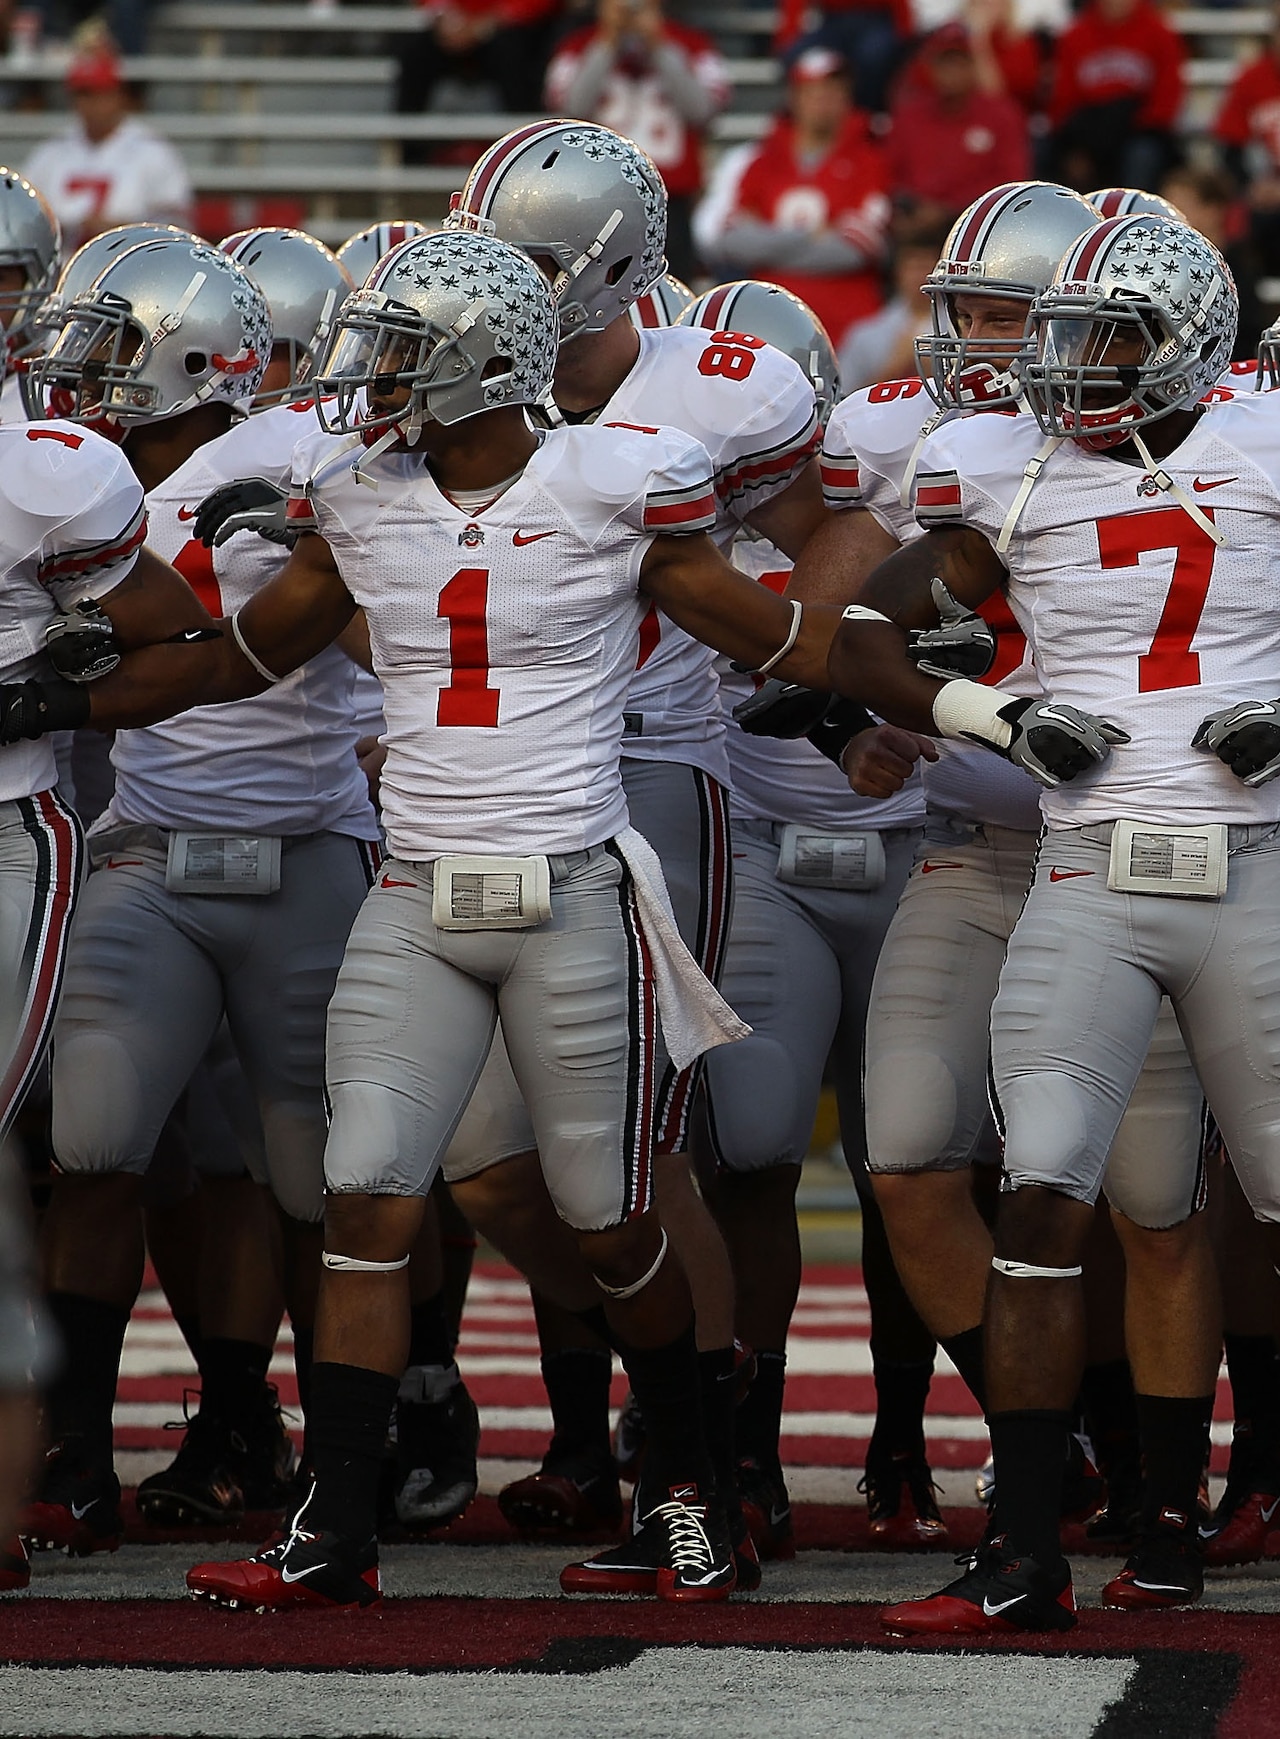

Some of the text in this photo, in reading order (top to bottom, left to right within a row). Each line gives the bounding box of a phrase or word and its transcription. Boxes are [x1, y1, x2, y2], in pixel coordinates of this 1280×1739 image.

[697, 330, 767, 382] 88
[26, 428, 85, 450] 1
[436, 568, 501, 728] 1
[1094, 506, 1217, 693] 7
